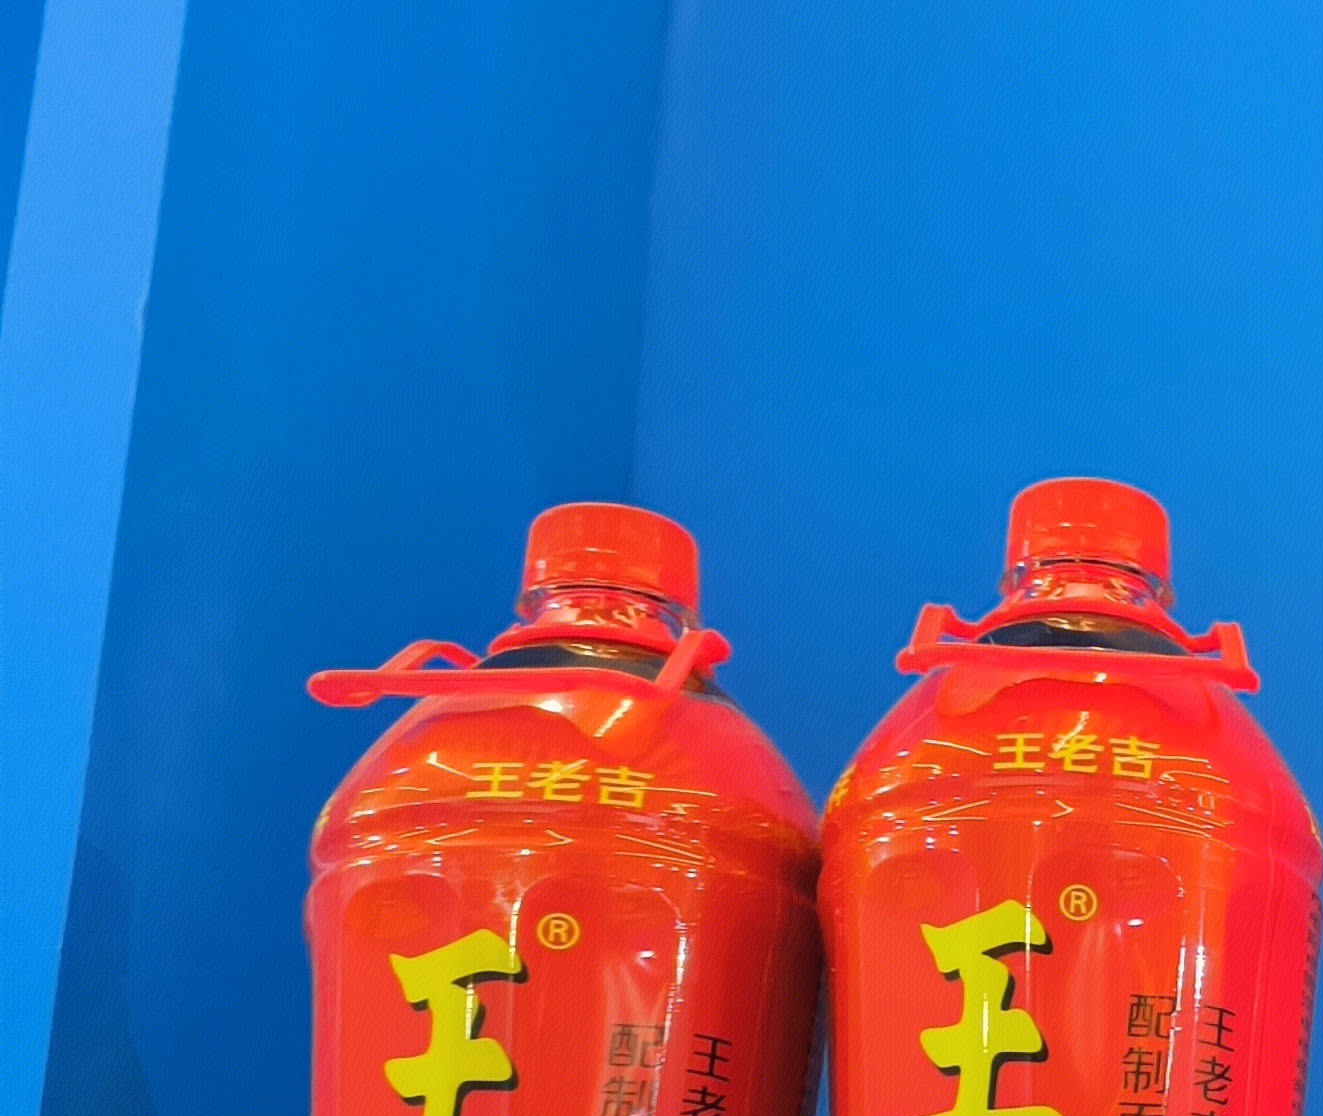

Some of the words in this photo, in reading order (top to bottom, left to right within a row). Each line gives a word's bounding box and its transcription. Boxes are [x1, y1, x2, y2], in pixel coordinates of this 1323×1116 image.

[993, 733, 1160, 779] 王老吉
[466, 761, 654, 808] 王老吉
